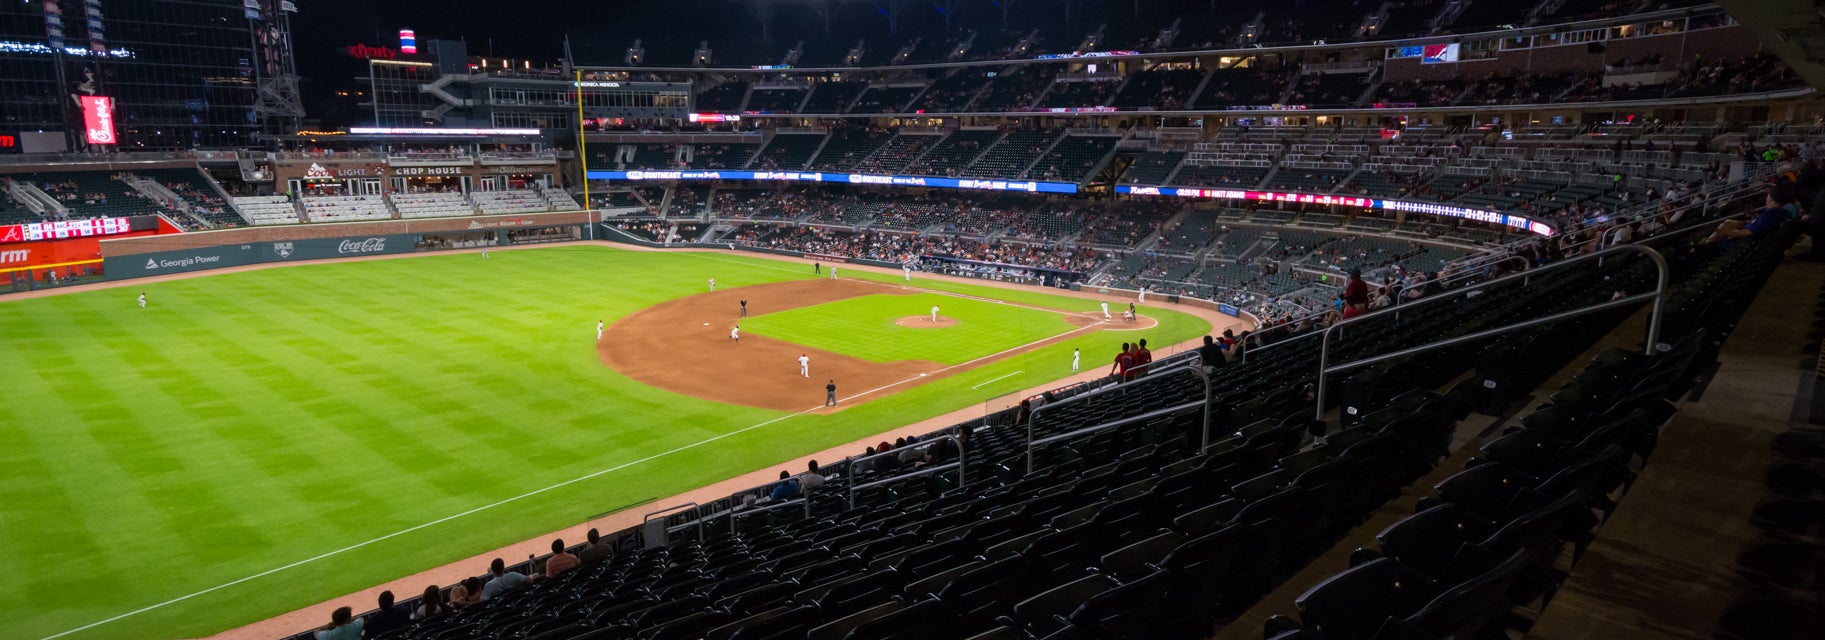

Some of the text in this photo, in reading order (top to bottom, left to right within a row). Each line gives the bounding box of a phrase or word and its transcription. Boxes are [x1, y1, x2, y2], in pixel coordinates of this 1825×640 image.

[348, 43, 397, 60] xfinity
[338, 168, 366, 176] LIGHT
[396, 166, 462, 175] CHOP HOUSE
[338, 237, 387, 254] Coca-Cola
[160, 254, 220, 268] Georgia Power
